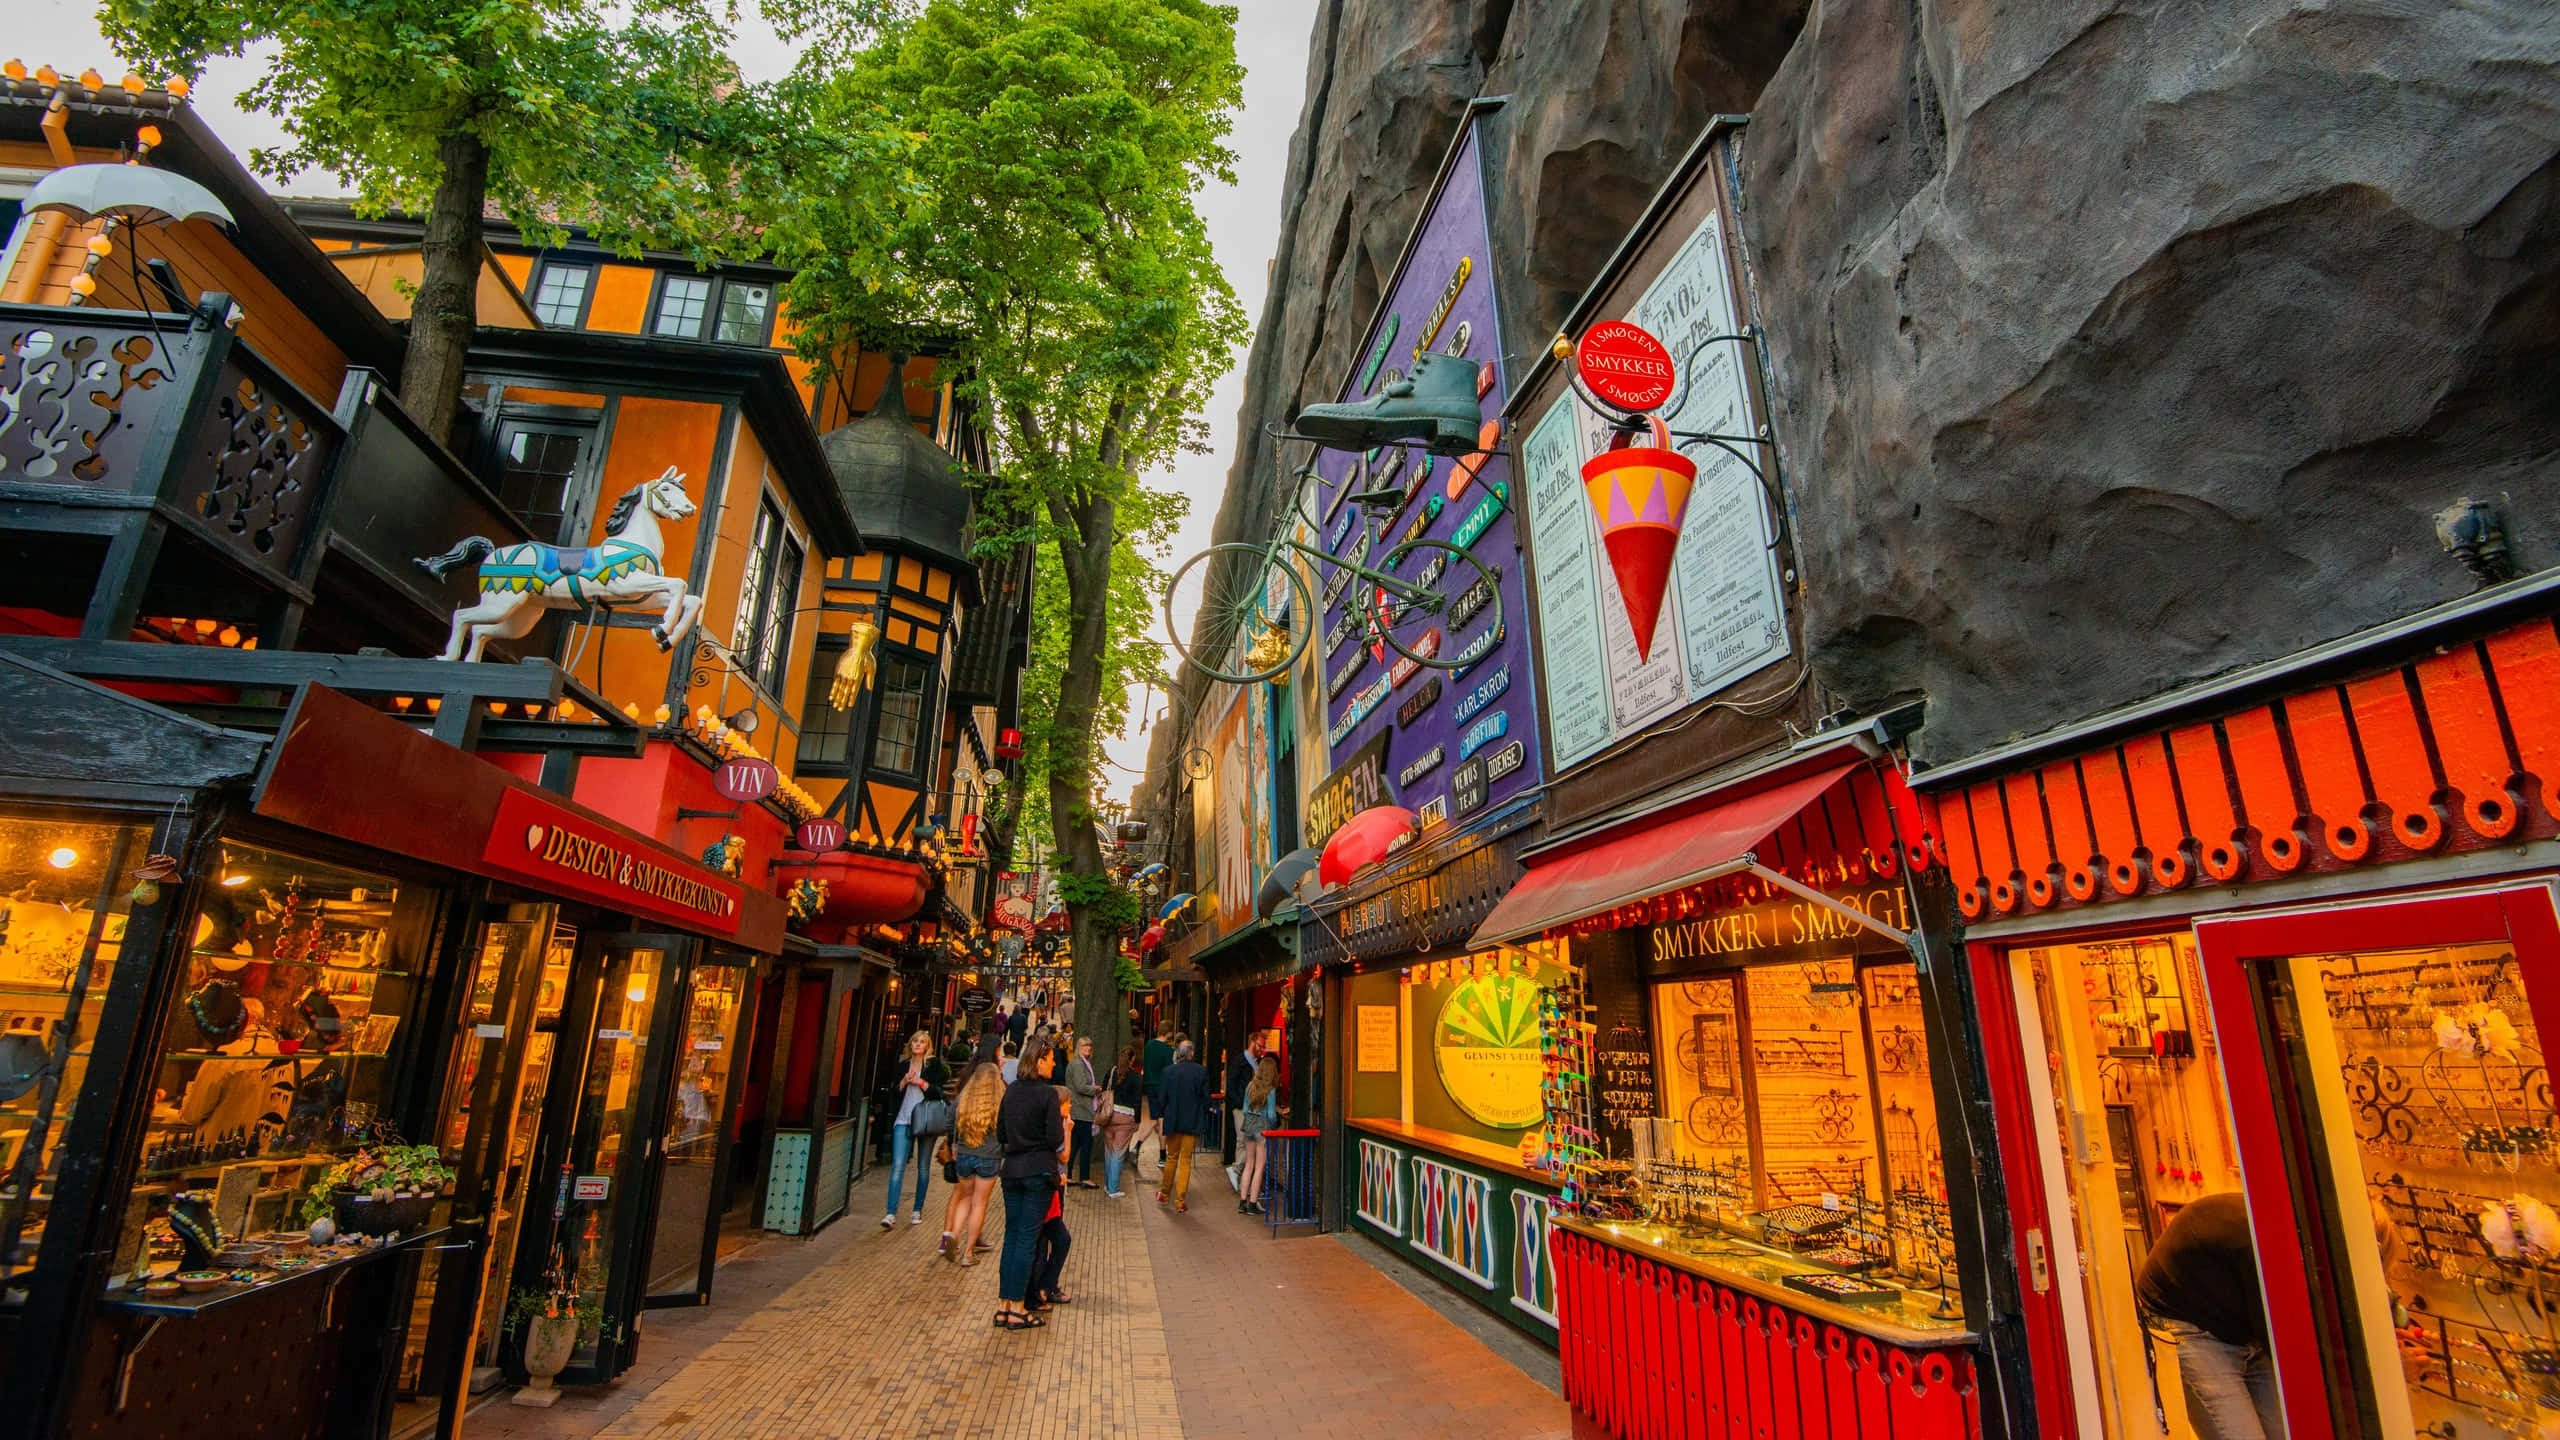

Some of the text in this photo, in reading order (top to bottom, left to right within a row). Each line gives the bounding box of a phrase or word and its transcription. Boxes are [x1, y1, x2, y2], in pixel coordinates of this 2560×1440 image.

[1422, 279, 1456, 345] LOHALS
[1592, 327, 1656, 353] I SMØGEN
[1585, 353, 1668, 377] SMYKKER
[1598, 378, 1664, 403] I SMØGEN
[1698, 453, 1736, 488] Armstrong
[1457, 497, 1491, 547] EMMY
[1456, 584, 1483, 618] INGE
[1402, 687, 1432, 723] HELGA
[727, 765, 767, 794] VIN
[1454, 763, 1477, 791] VENUS
[1488, 747, 1518, 778] ODENSE
[1309, 754, 1379, 845] SMØGEN
[1459, 788, 1478, 811] TEJN
[807, 824, 837, 847] VIN
[543, 825, 728, 918] DESIGN & SMYKKEKUNST
[1340, 878, 1440, 937] PJERROT SPIL
[1653, 913, 1767, 962] SMYKKER
[1771, 909, 1784, 947] I
